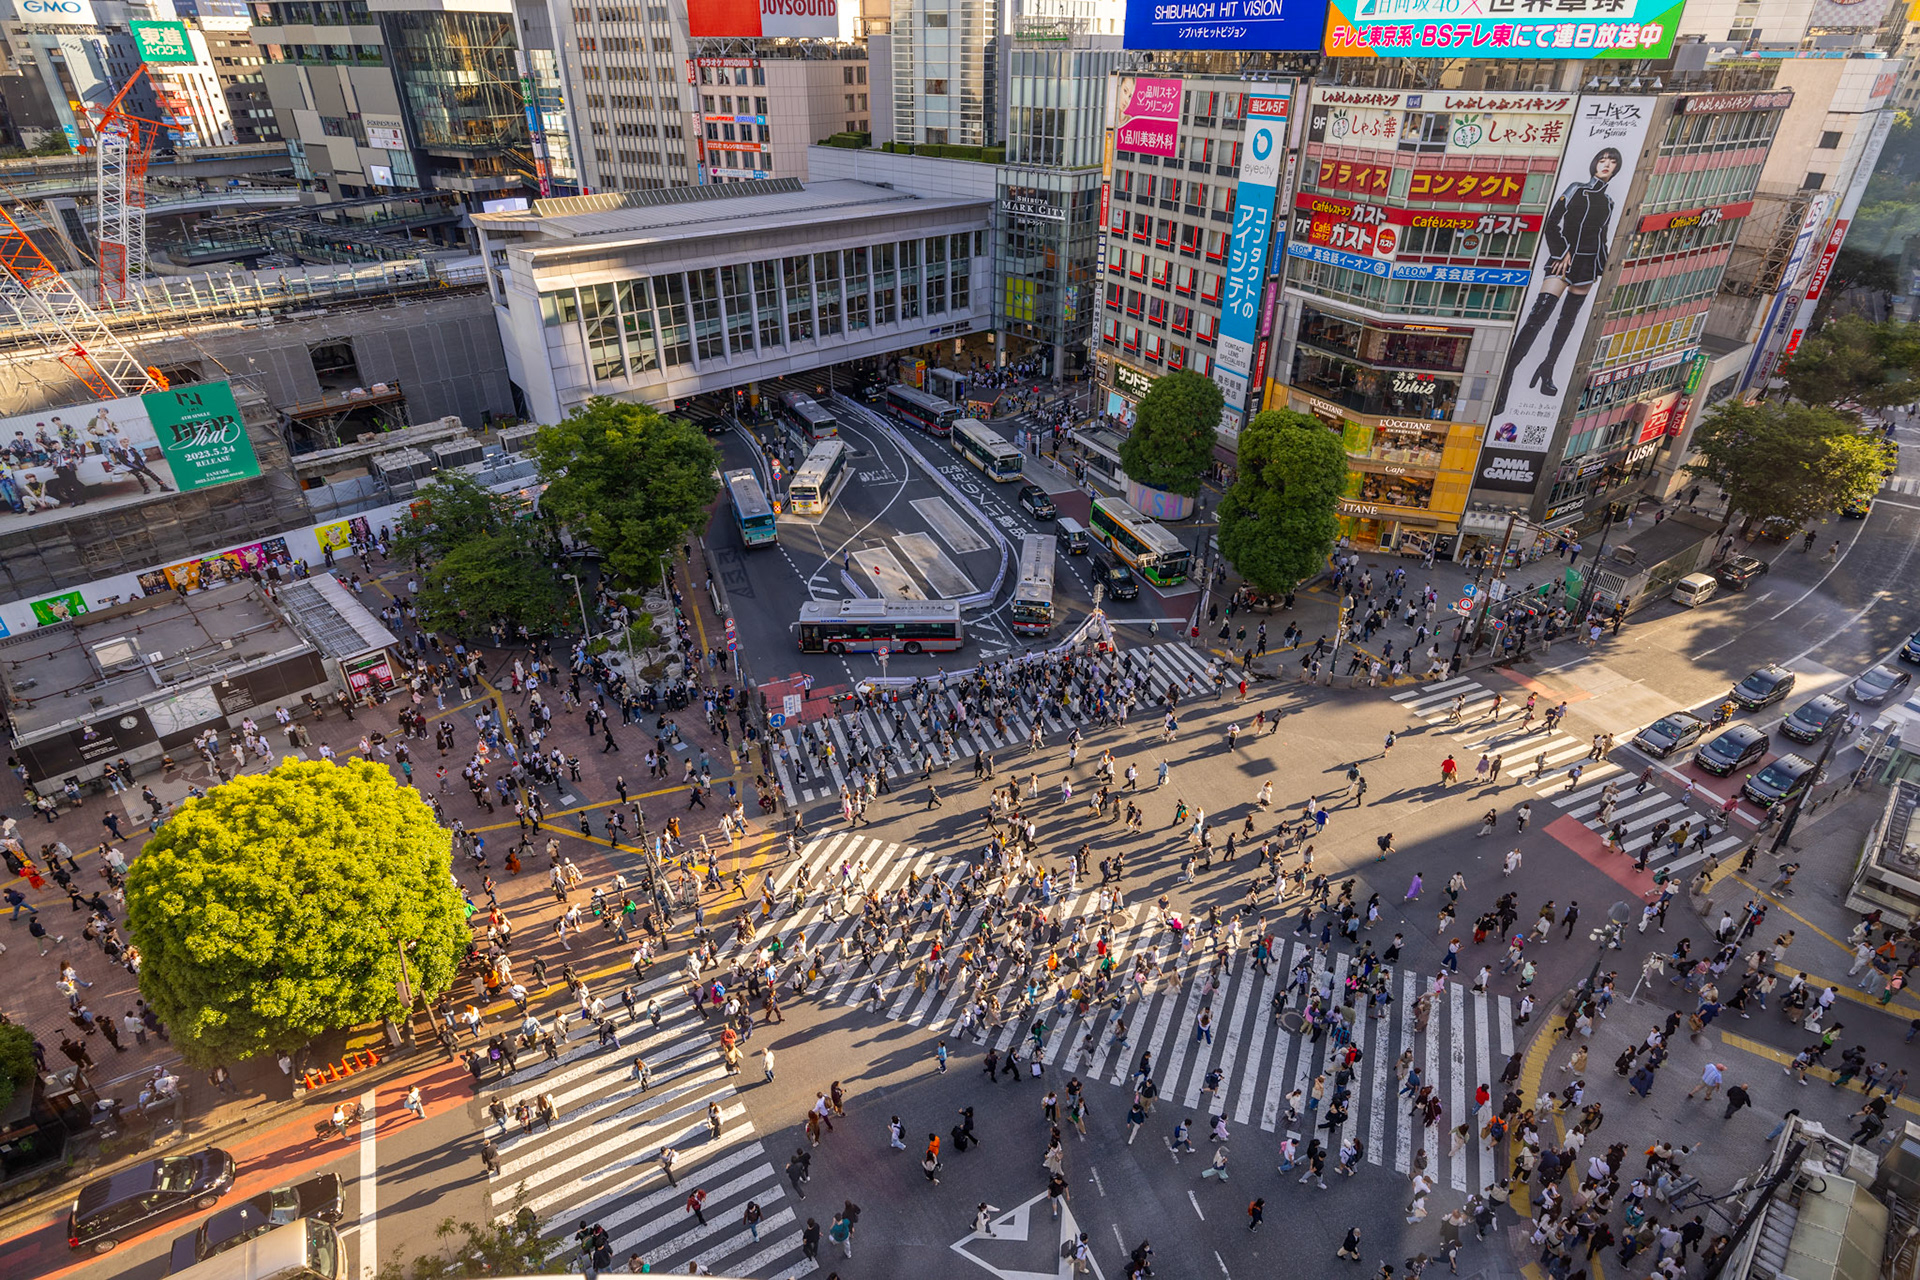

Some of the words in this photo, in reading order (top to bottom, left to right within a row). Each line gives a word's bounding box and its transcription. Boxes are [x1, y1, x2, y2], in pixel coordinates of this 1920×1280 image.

[24, 0, 81, 13] GMO
[762, 0, 836, 16] JOYSOUND
[1155, 2, 1215, 20] SHIBUHACHI
[1220, 1, 1239, 17] HIT
[1249, 0, 1283, 16] VISION
[138, 27, 184, 46] 東進
[1179, 27, 1247, 39] シブハチヒットビジョン
[146, 45, 187, 55] ハイスクール
[700, 58, 722, 67] カラオケ
[723, 59, 750, 67] JOYSOUND
[1145, 86, 1179, 100] 品川スキン
[1144, 99, 1174, 114] クリニック
[1251, 99, 1285, 114] 当ビル5F
[1586, 102, 1642, 120] コードギアス
[1314, 117, 1326, 129] 9F
[1352, 114, 1397, 139] しゃぶ葉
[1124, 129, 1174, 149] 品川美容外科
[1488, 120, 1562, 145] しゃぶ葉
[1244, 163, 1274, 178] eyecity
[1321, 162, 1388, 189] プライス
[1411, 174, 1520, 198] コンタクト
[1017, 195, 1048, 205] SHIBUYA
[1001, 200, 1034, 213] MARK
[1038, 206, 1067, 217] CITY
[1352, 203, 1387, 226] ガスト
[1475, 214, 1529, 235] ガスト
[1699, 207, 1723, 227] ガスト
[1296, 218, 1311, 234] 7F
[1313, 221, 1331, 234] Café
[1332, 222, 1373, 250] ガスト
[1229, 204, 1254, 315] アイシティ
[1242, 207, 1268, 319] コンタクトの
[1313, 248, 1373, 271] 英会話イーオン
[1397, 266, 1428, 278] AEON
[1434, 267, 1528, 283] 英会話イーオン
[1810, 251, 1836, 292] TaxFree
[1225, 341, 1244, 353] CONTACT
[1684, 349, 1699, 361] 4F
[1220, 353, 1246, 368] SPECIALISTS
[1393, 379, 1437, 395] Ushi8
[191, 411, 211, 419] SINGLE
[1310, 397, 1343, 417] L'OCCITANE
[1379, 418, 1431, 430] L'OCCITANE
[1648, 411, 1669, 428] アコム
[170, 414, 234, 443] DROP
[184, 445, 236, 462] 2023.5.24
[195, 455, 231, 468] RELEASE
[1625, 442, 1656, 465] LUSH
[1385, 465, 1405, 475] Café
[1493, 457, 1530, 471] DMM
[1483, 467, 1534, 483] GAMES
